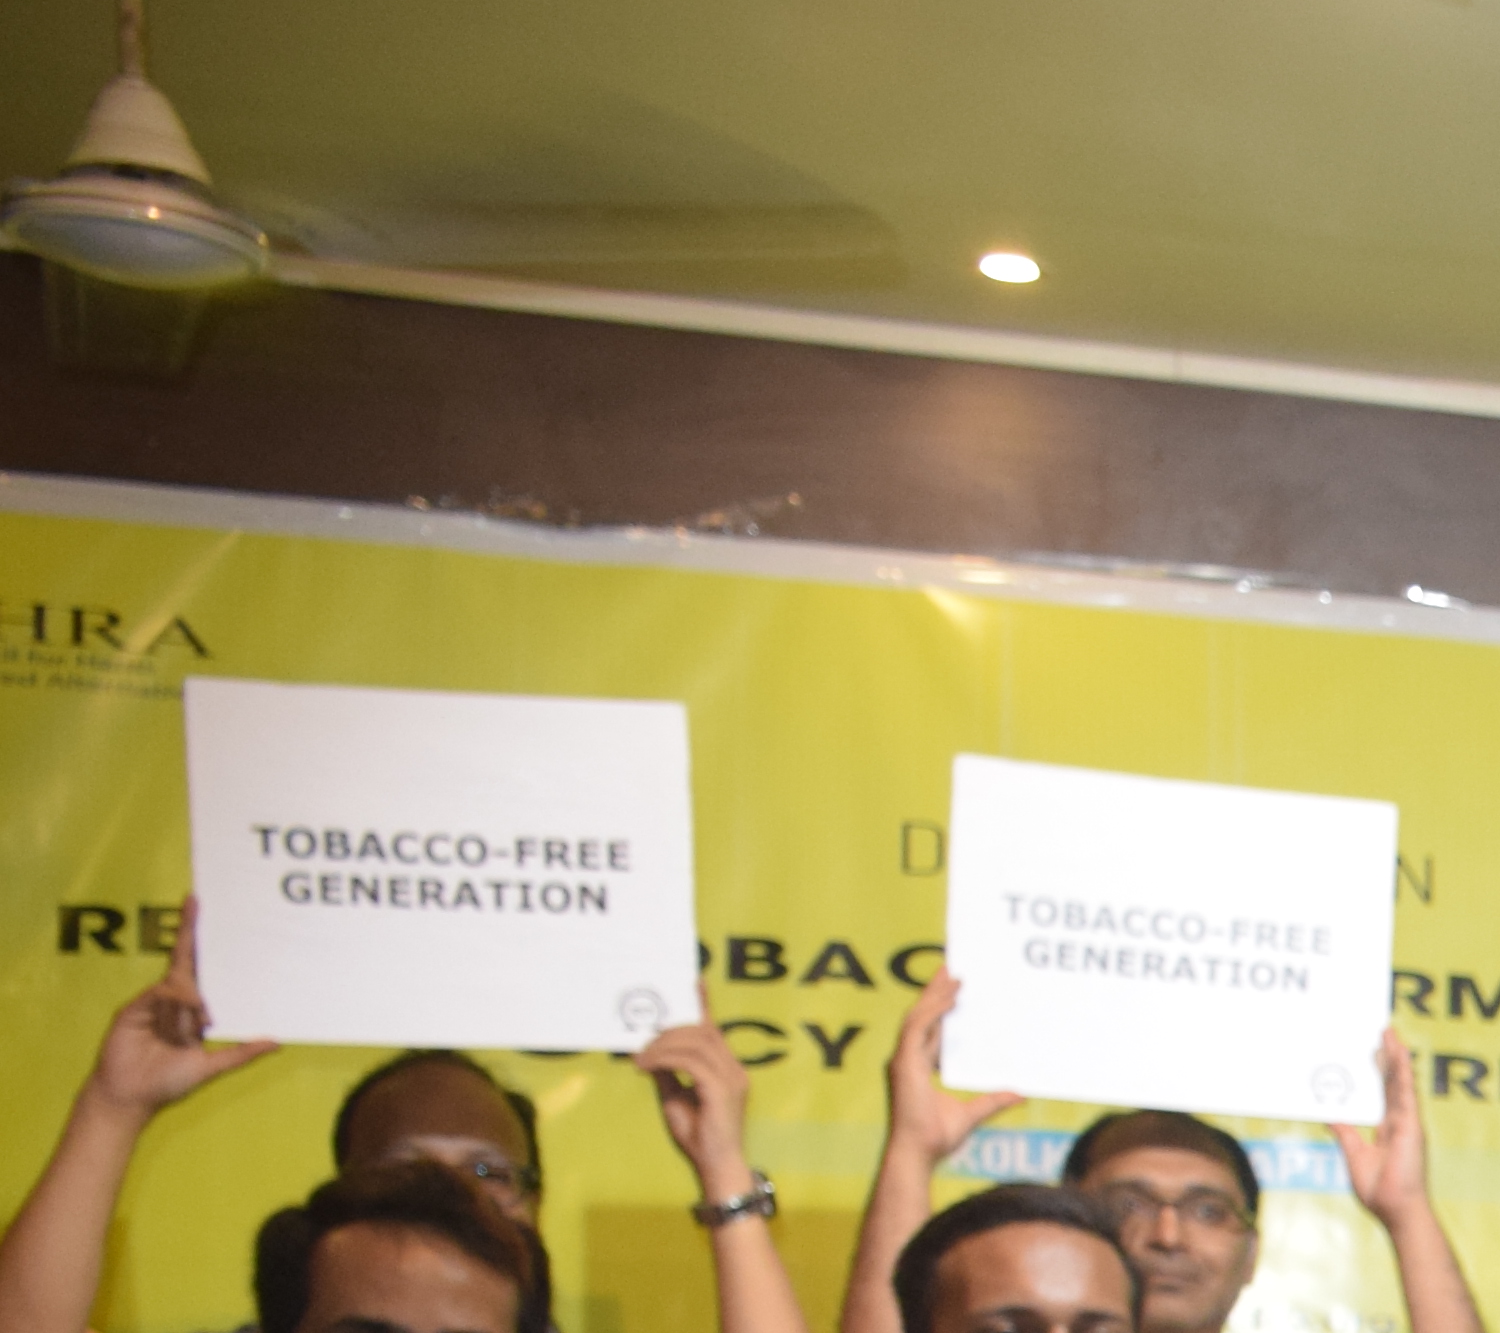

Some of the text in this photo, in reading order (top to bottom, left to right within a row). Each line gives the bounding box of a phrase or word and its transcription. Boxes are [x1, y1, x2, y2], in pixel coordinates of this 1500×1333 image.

[253, 826, 632, 872] TOBACCO-FREE
[281, 875, 609, 914] GENERATION
[1002, 895, 1332, 955] TOBACCO-FREE
[1023, 938, 1309, 992] GENERATION
